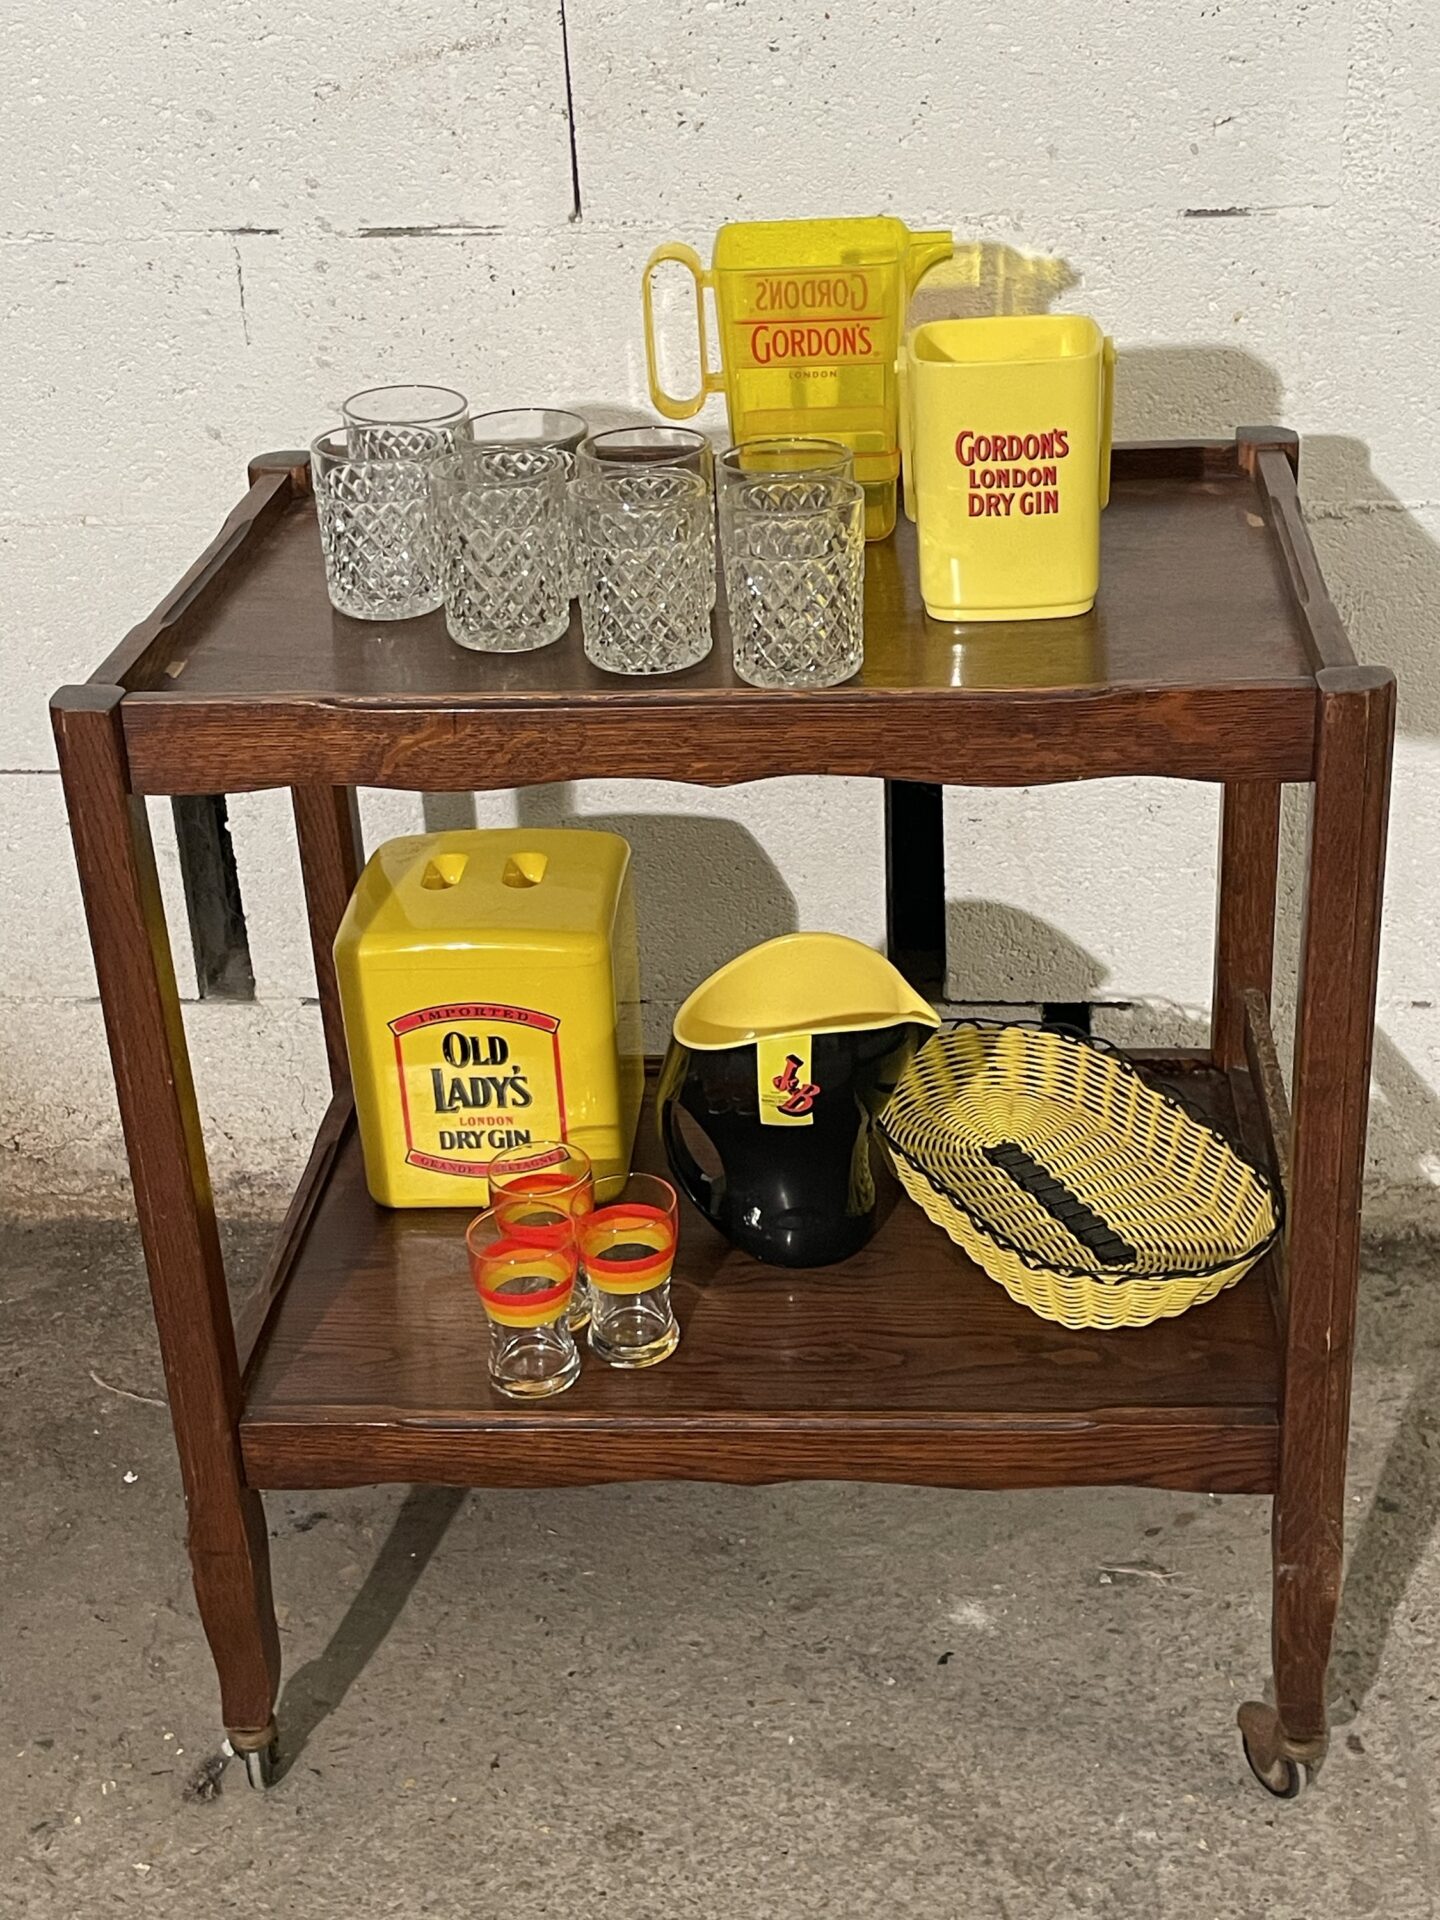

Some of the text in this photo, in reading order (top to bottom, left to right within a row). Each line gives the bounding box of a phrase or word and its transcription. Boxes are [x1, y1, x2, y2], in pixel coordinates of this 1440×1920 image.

[751, 323, 872, 364] GORDON'S
[789, 370, 838, 380] LONDON
[955, 428, 1070, 467] GORDON'S
[969, 466, 1057, 489] LONDON
[968, 490, 1059, 517] DRY GIN
[418, 1006, 530, 1023] IMPORTED
[442, 1031, 509, 1068] OLD
[430, 1065, 533, 1114] LADY'S
[459, 1116, 514, 1126] LONDON
[439, 1129, 533, 1150] DRY GIN
[420, 1157, 476, 1174] GRANDE
